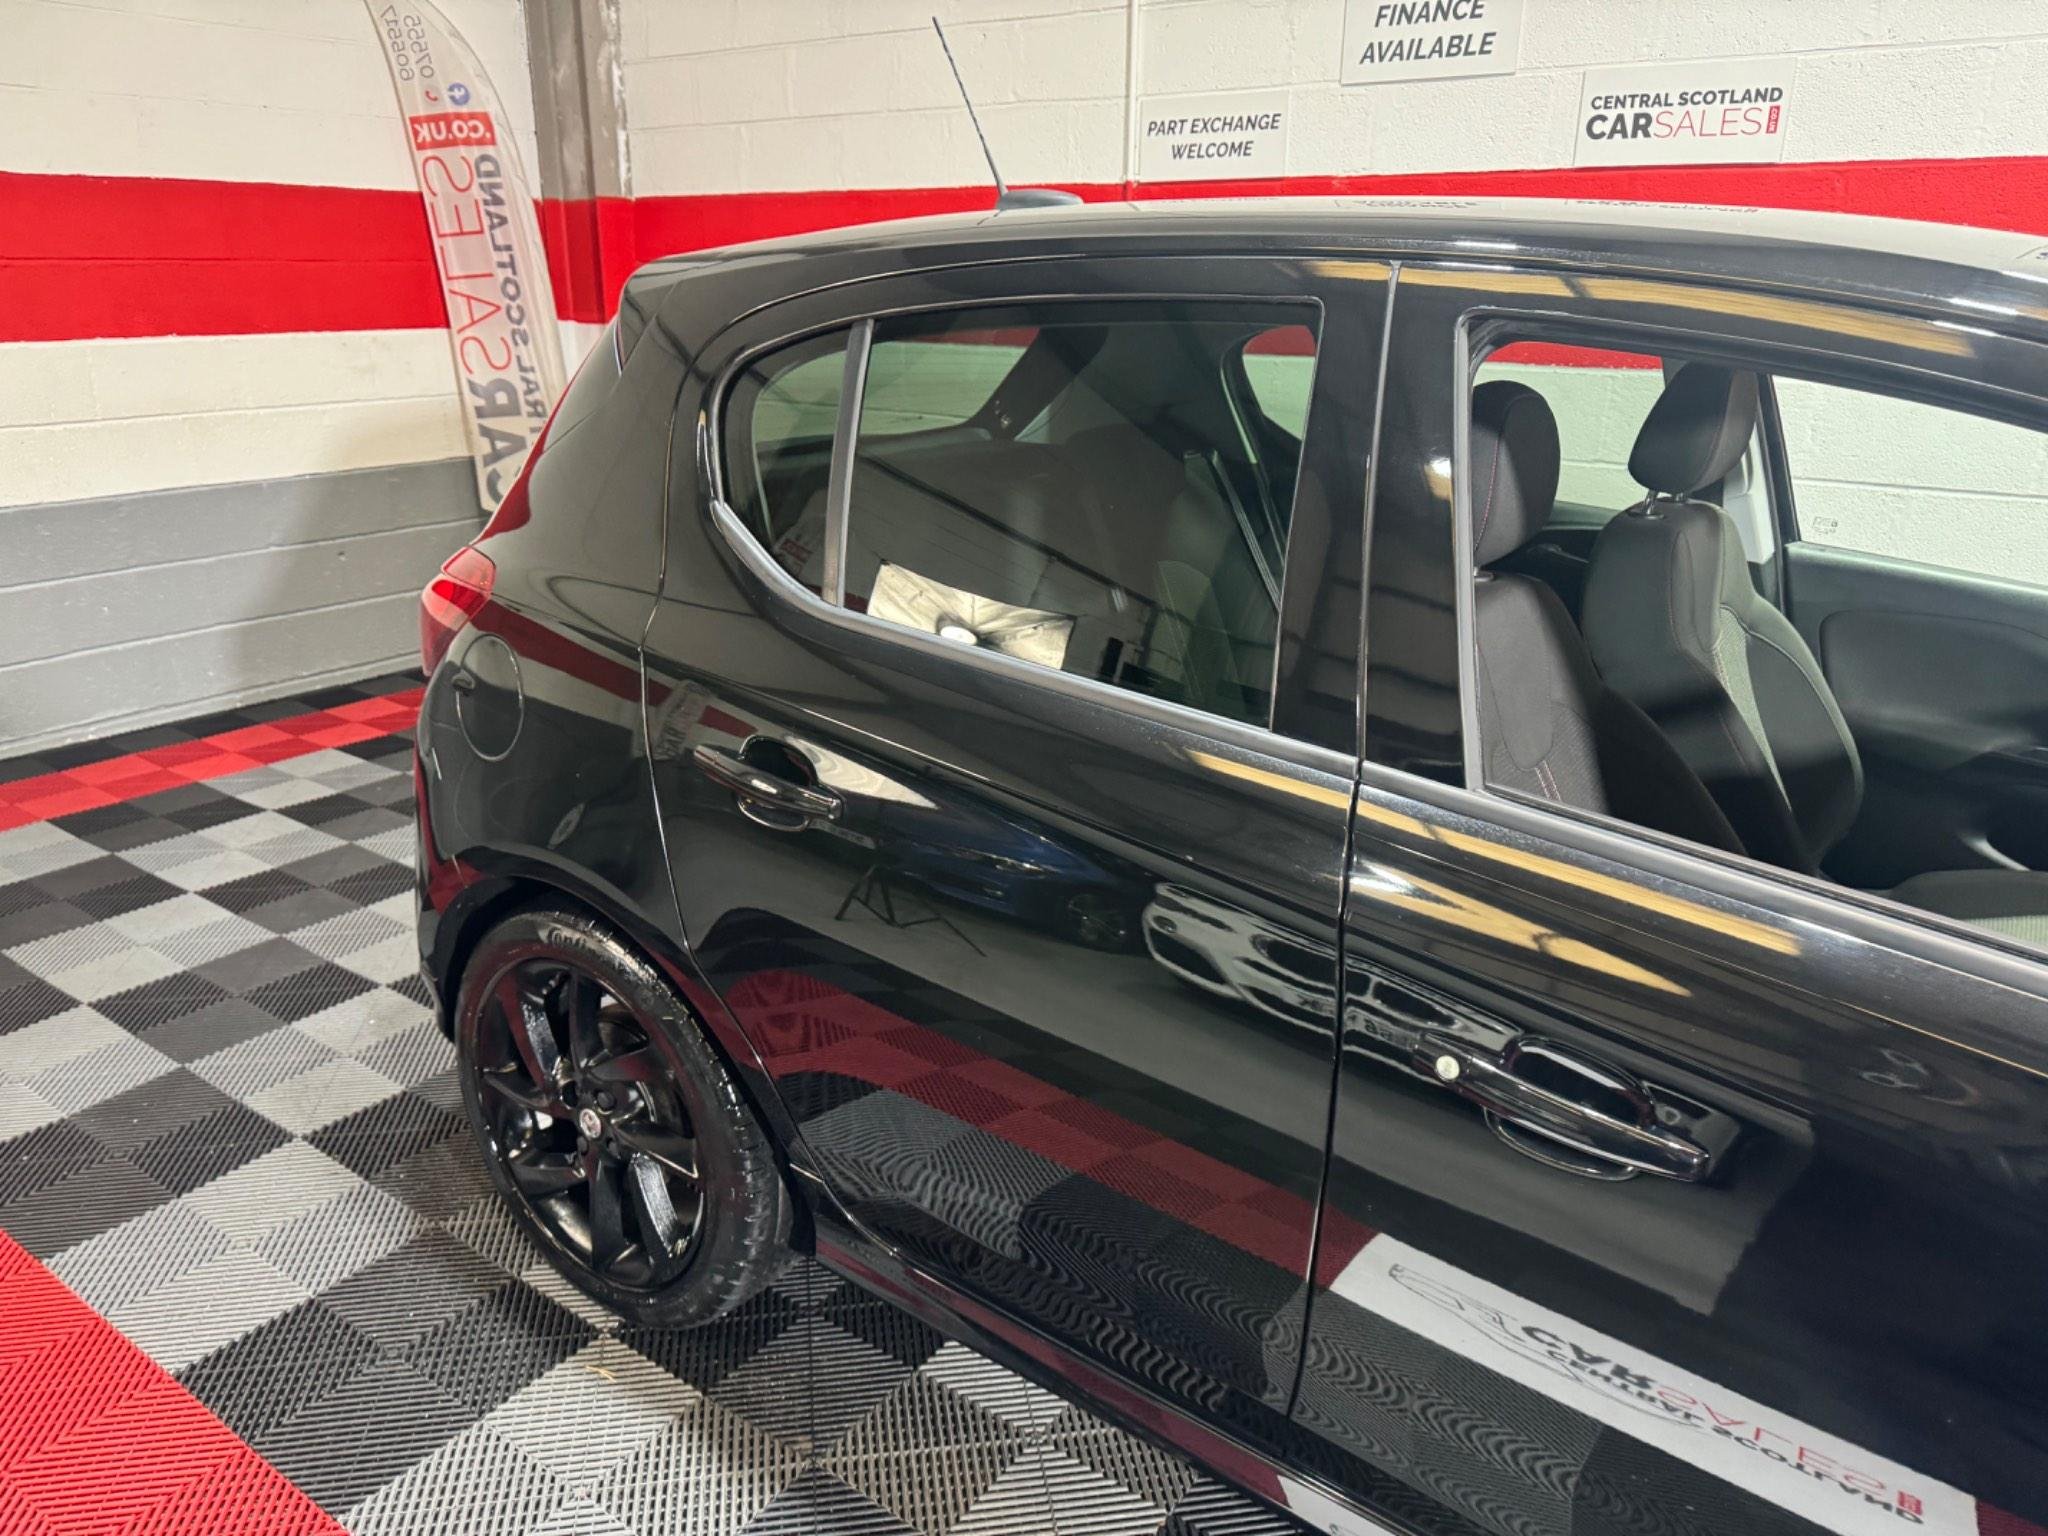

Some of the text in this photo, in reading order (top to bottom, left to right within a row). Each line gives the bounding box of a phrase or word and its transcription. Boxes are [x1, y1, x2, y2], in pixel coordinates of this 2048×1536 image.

[1375, 0, 1485, 27] FINANCE
[1359, 32, 1497, 64] AVAILABLE
[1591, 87, 1783, 110] CENTRAL SCOTLAND
[1147, 113, 1282, 137] PART EXCHANGE
[1172, 141, 1254, 160] WELCOME
